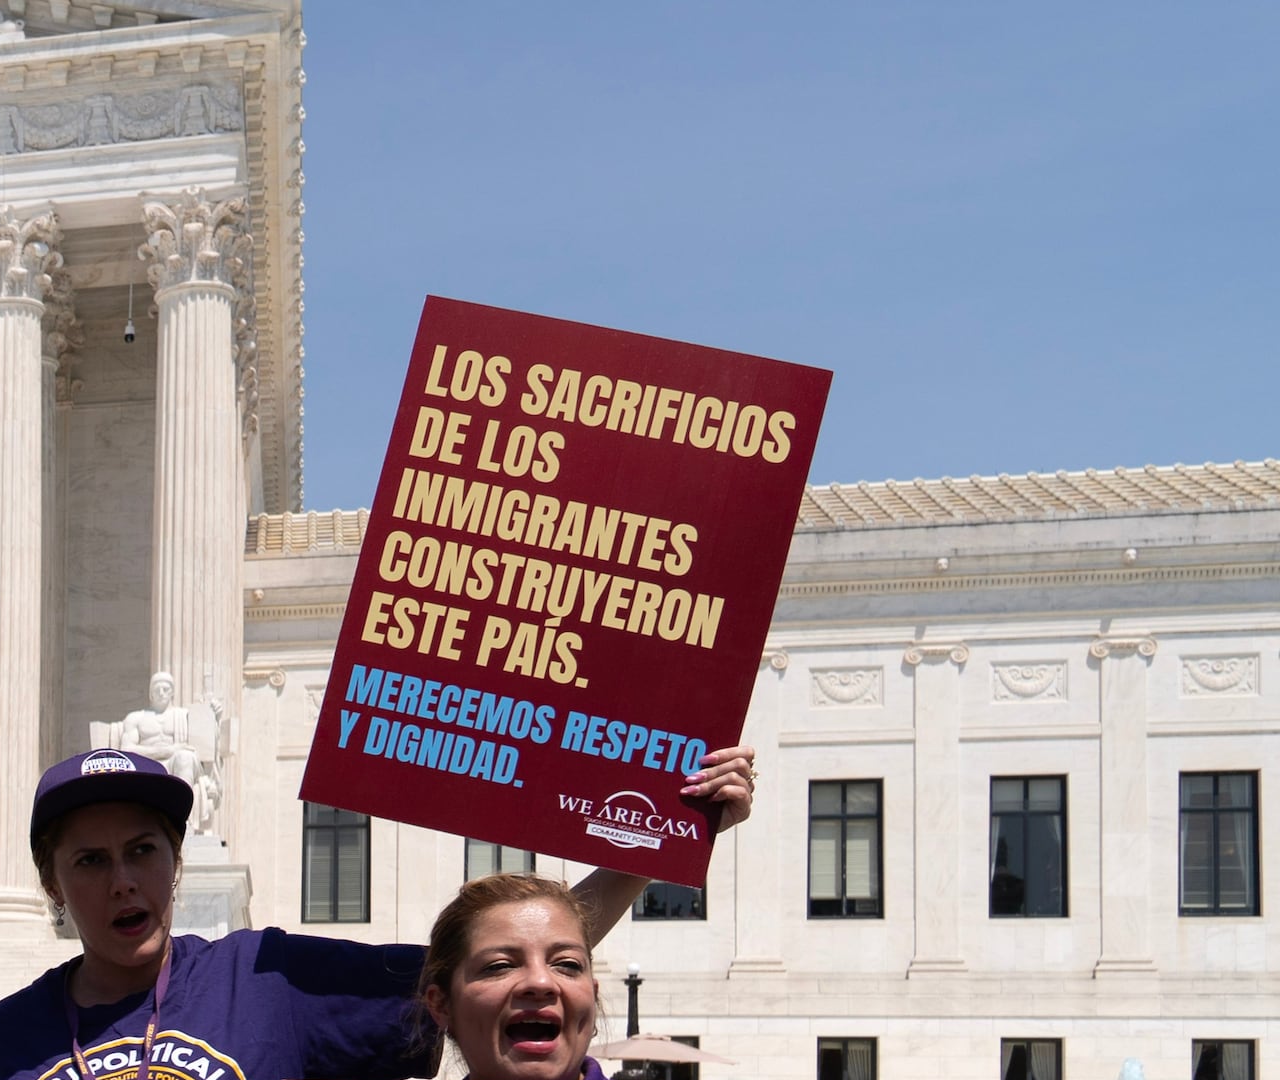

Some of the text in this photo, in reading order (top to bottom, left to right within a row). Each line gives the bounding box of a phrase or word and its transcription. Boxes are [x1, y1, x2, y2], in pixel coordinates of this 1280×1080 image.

[408, 405, 566, 484] DE LOS
[423, 344, 797, 465] LOS SACRIFICIOS
[392, 467, 699, 577] INMIGRANTES
[360, 590, 589, 690] ESTE PAÍS.
[378, 530, 726, 650] CONSTRUYERON
[337, 708, 525, 789] Y DIGNIDAD.
[344, 663, 708, 778] MERECEMOS RESPETO
[558, 793, 700, 841] WE ARE CASA
[592, 827, 656, 846] COMMUNITY POWER
